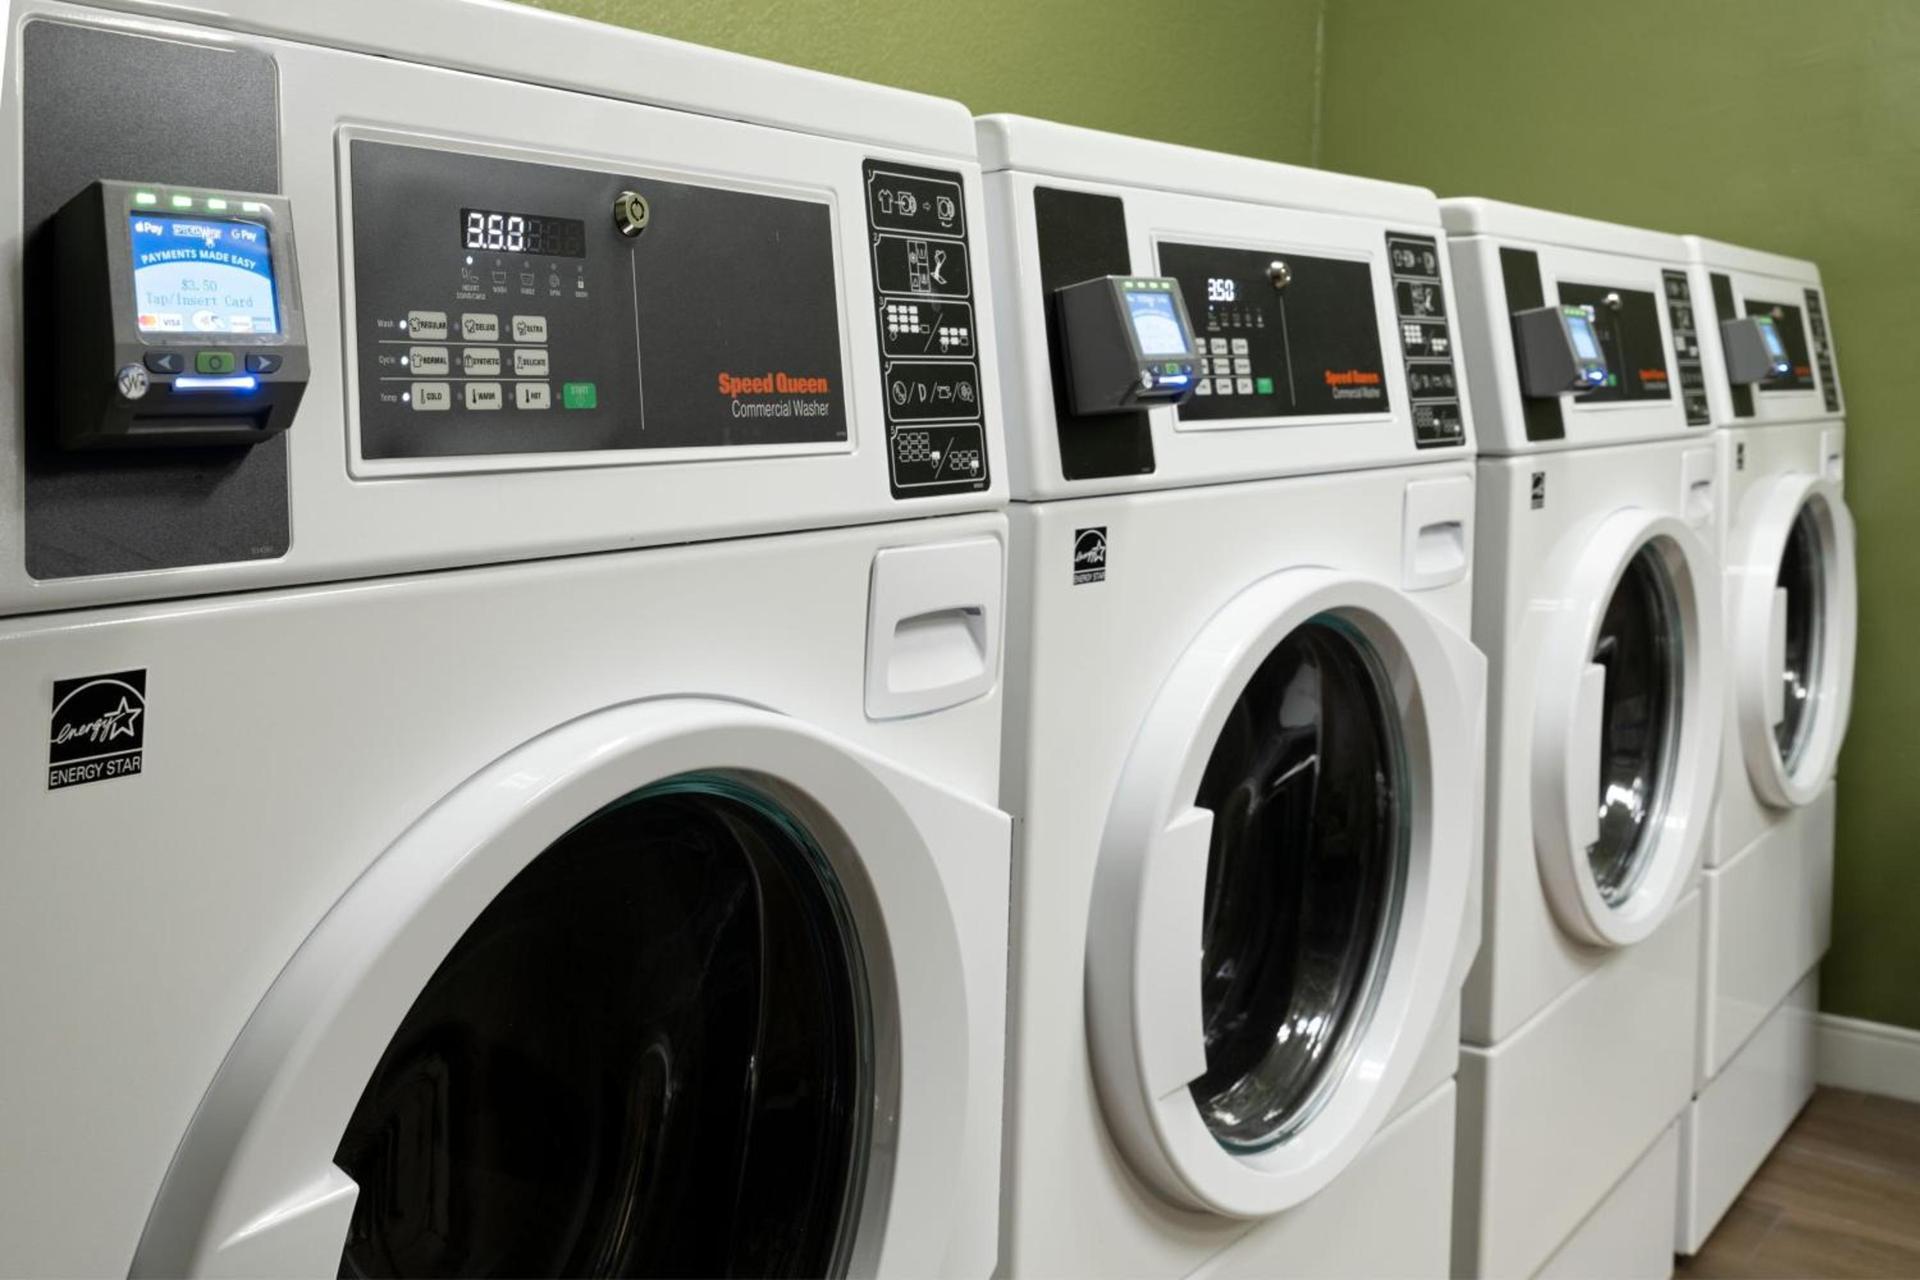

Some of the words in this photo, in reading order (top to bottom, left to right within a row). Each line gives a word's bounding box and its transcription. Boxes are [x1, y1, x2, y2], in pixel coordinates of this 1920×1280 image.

[144, 222, 163, 235] Pay
[141, 249, 197, 264] PAYMENTS
[199, 249, 230, 263] MADE
[231, 255, 256, 269] EASY
[181, 279, 218, 292] $3.50
[146, 292, 217, 307] Tap/Insert
[224, 294, 254, 308] Card
[163, 319, 180, 327] VISA
[377, 319, 394, 328] Wash
[420, 320, 447, 329] REGULAR
[423, 356, 447, 365] NORMAL
[718, 372, 774, 397] Speed
[775, 371, 829, 393] Queen
[426, 392, 442, 400] COLD
[478, 392, 496, 401] WARM
[530, 392, 542, 400] HOT
[731, 399, 792, 418] Commercial
[792, 399, 830, 417] Washer
[57, 717, 113, 744] energy
[49, 763, 104, 786] ENERGY
[106, 756, 141, 776] STAR
